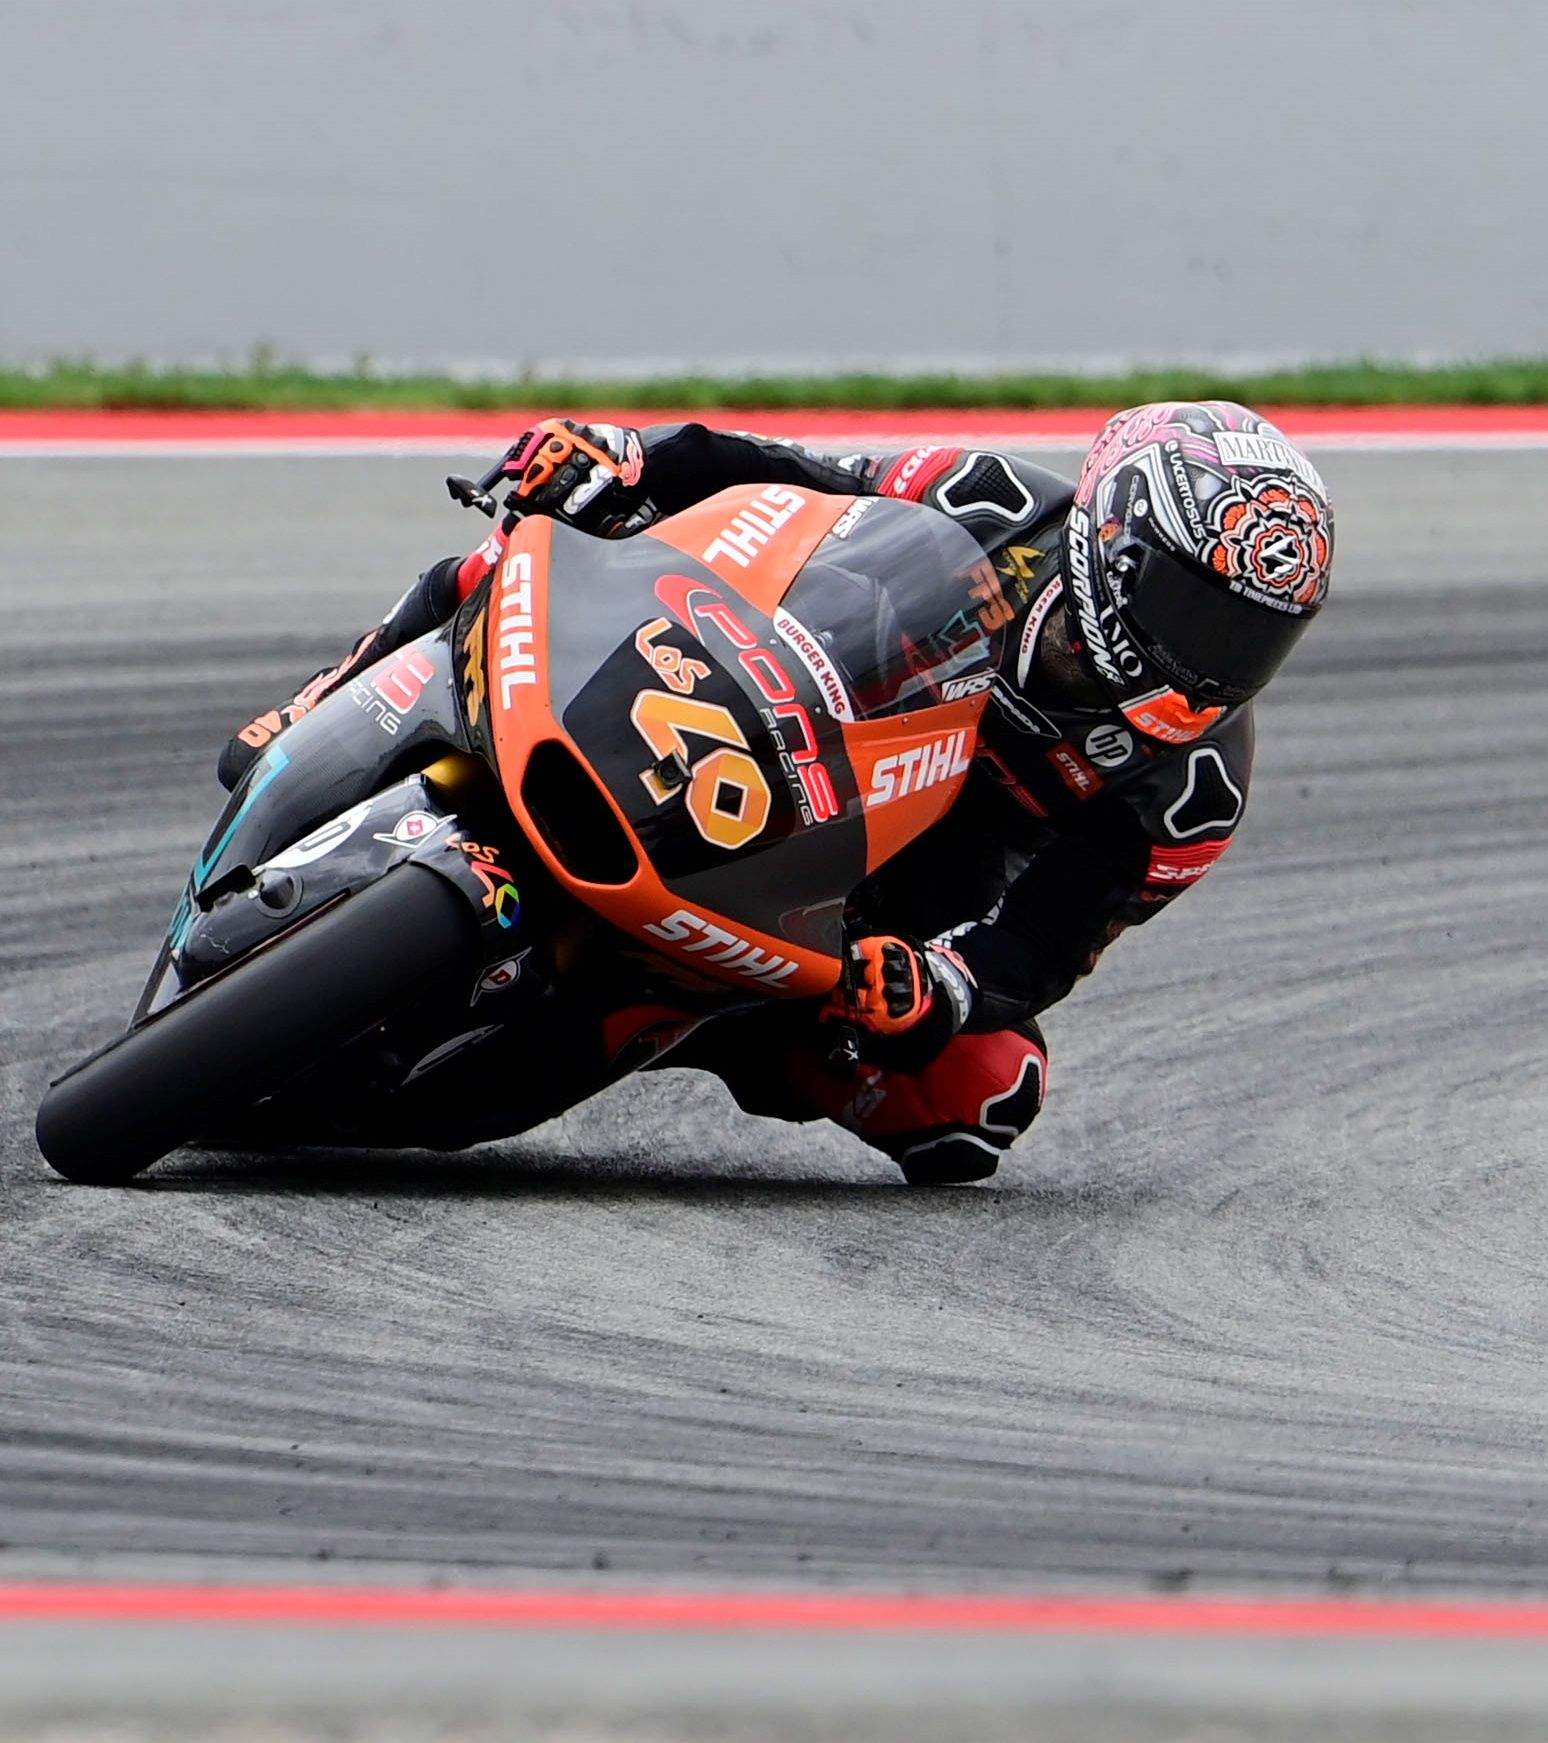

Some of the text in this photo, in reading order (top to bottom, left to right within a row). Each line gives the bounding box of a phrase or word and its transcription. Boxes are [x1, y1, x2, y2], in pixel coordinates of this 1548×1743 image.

[702, 485, 807, 568] STIHL
[500, 552, 537, 710] STIHL
[1068, 509, 1120, 678] SCORPION
[777, 617, 848, 717] BURGER KING
[866, 729, 977, 808] STIHL
[1055, 750, 1093, 793] STIHL
[1087, 725, 1131, 766] hp
[642, 908, 800, 990] STIHL
